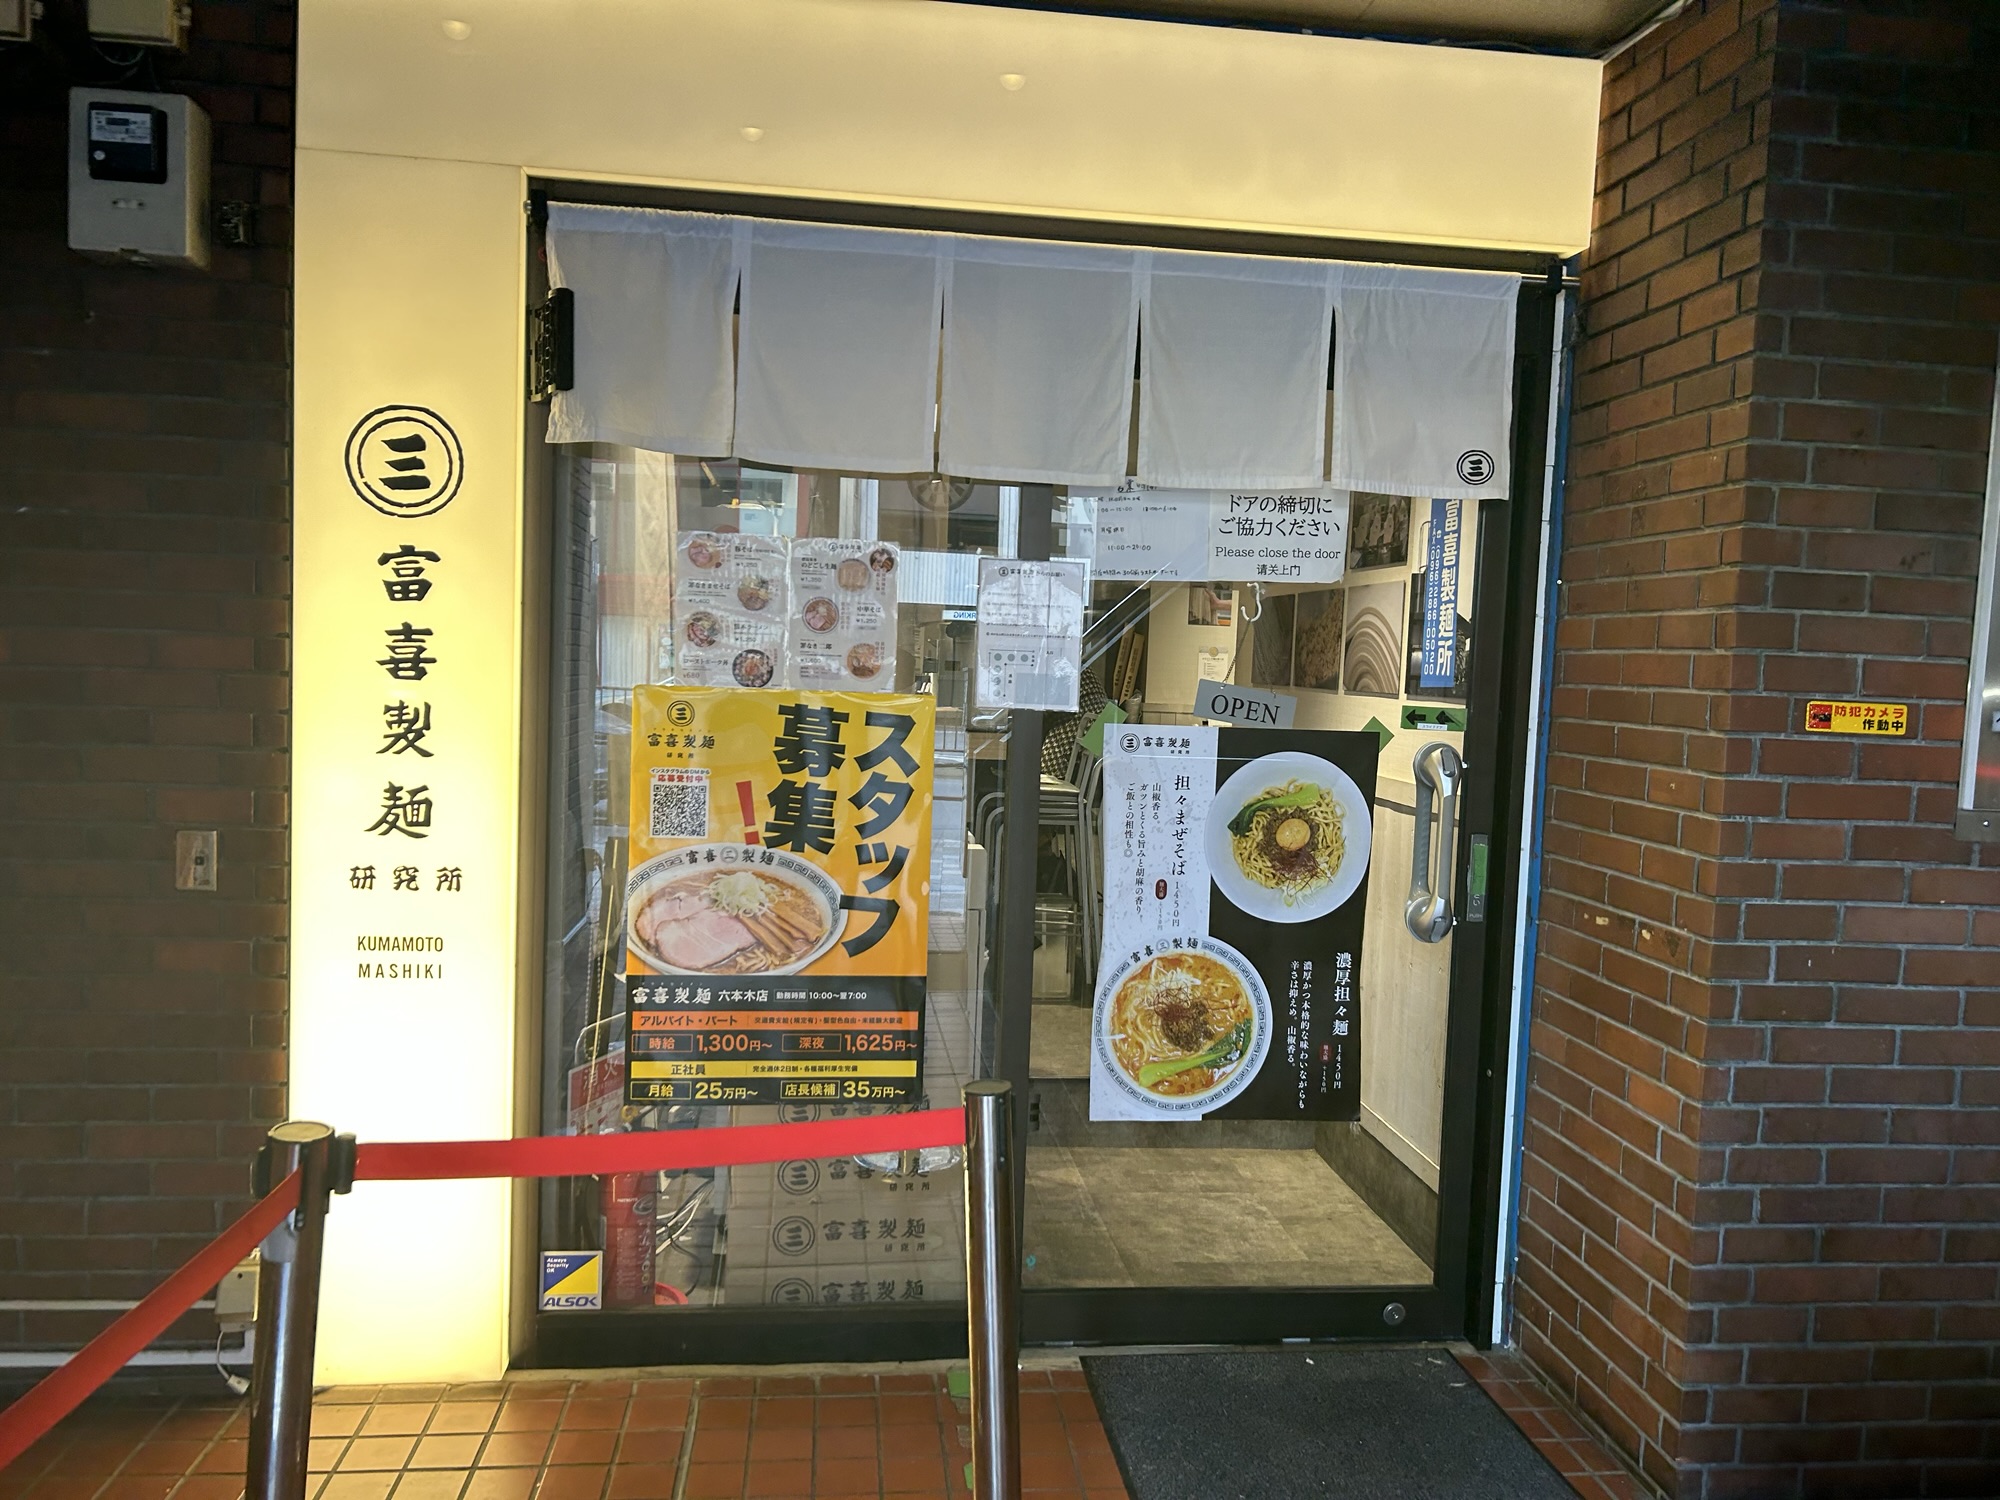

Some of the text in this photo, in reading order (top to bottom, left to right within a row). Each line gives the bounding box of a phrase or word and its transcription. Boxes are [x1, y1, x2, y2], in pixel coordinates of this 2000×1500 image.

[1228, 494, 1333, 515] ドアの締切に
[1218, 517, 1341, 537] ご協力ください
[1215, 546, 1341, 559] Please close the door
[1256, 564, 1301, 576] 请关上门
[1210, 694, 1280, 725] OPEN
[1834, 705, 1904, 719] 防犯カメラ
[1863, 719, 1903, 731] 作動中
[647, 733, 715, 749] 富喜製麺
[1143, 737, 1191, 748] 富喜製麺
[658, 774, 703, 783] 応募受付中
[763, 703, 850, 855] 募集
[1171, 775, 1191, 876] 担々まぜそば
[839, 710, 920, 958] スタッフ
[349, 865, 463, 892] 研究所
[357, 935, 444, 952] KUMAMOTO
[358, 963, 443, 979] MASHIKI
[632, 987, 712, 1004] 富喜製麺
[718, 989, 769, 1002] 六本木店
[776, 991, 806, 999] 勤務時間
[1332, 952, 1352, 1036] 濃厚担々麺
[649, 1037, 676, 1050] 時給
[799, 1037, 825, 1049] 深夜
[671, 1064, 706, 1075] 正社員
[648, 1084, 674, 1097] 月給
[785, 1083, 836, 1096] 店長候補
[823, 1218, 926, 1241] 富喜製麺
[543, 1296, 598, 1307] ALSOK
